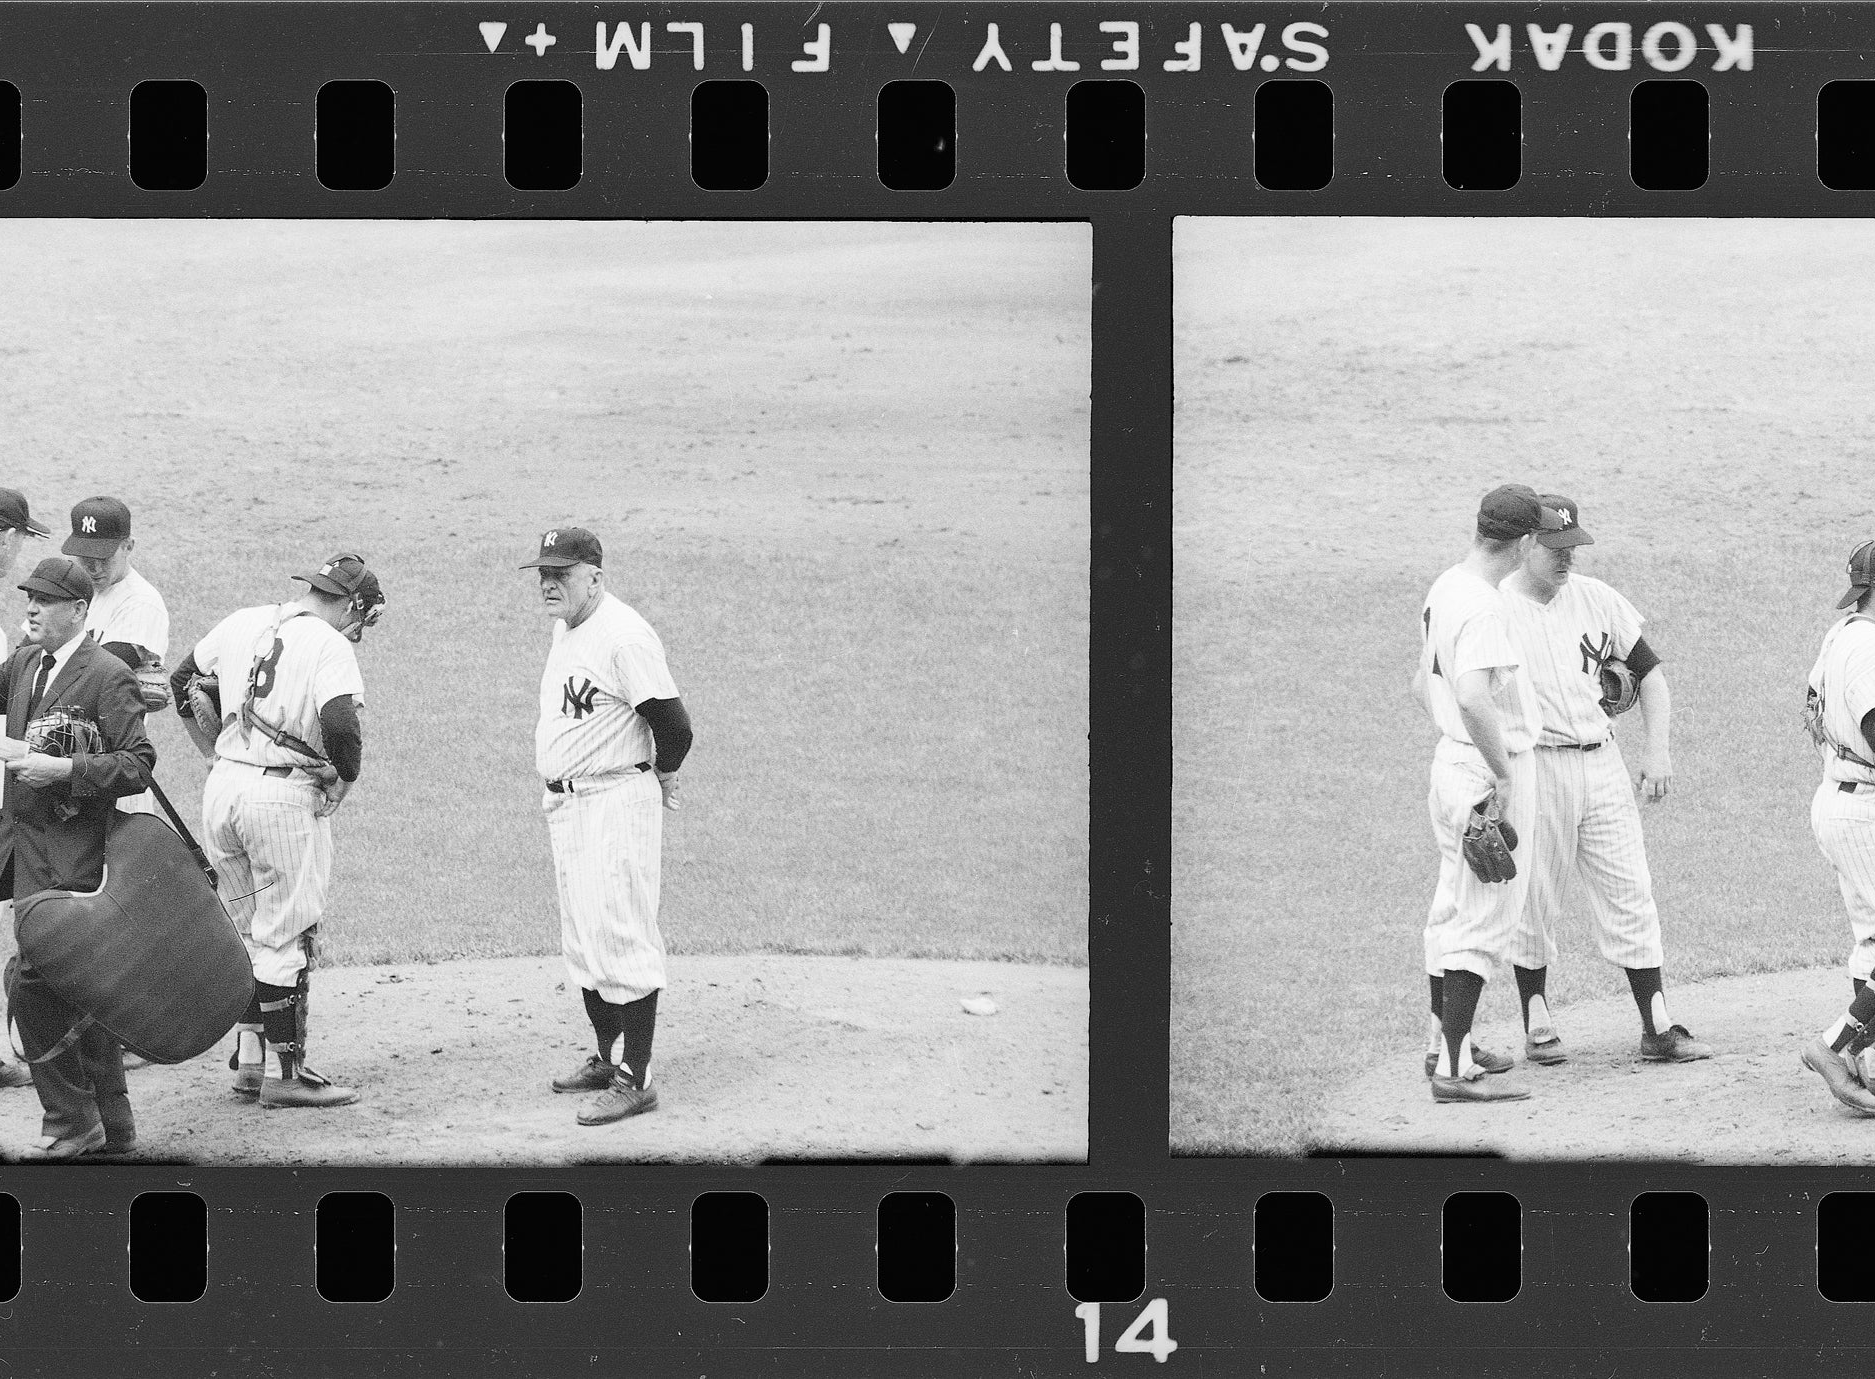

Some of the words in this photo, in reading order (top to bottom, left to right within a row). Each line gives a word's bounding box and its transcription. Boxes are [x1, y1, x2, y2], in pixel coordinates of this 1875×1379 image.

[595, 22, 830, 73] FILM
[1466, 22, 1756, 72] KODAK
[1075, 1299, 1177, 1364] 14
